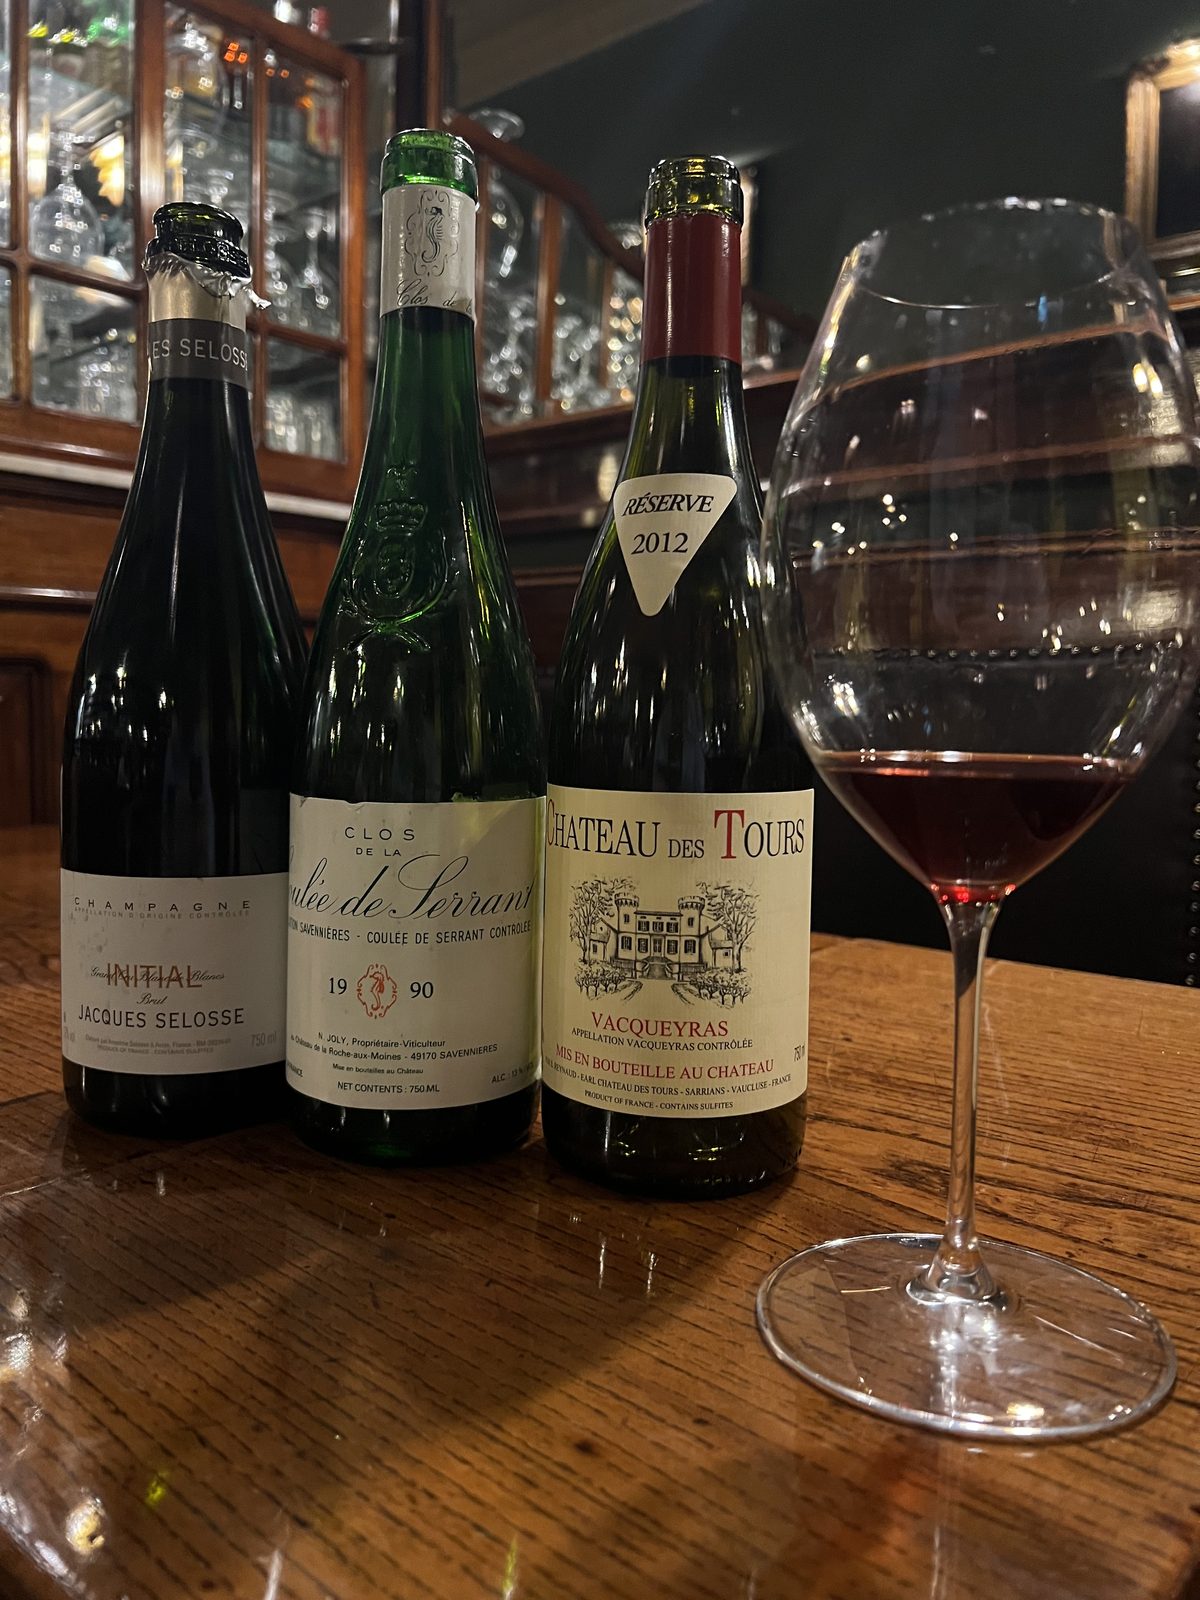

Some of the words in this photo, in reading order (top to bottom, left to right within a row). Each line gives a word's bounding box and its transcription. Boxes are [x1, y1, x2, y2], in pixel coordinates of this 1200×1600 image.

[397, 279, 429, 306] Clos
[621, 492, 714, 517] RÉSERVE
[631, 532, 689, 555] 2012
[344, 826, 416, 841] CLOS
[547, 799, 661, 857] CHATEAU
[668, 839, 705, 858] DES
[714, 809, 805, 859] TOURS
[356, 847, 373, 855] DE
[384, 849, 402, 857] LA
[331, 865, 392, 917] de
[388, 853, 538, 919] Serrant
[74, 897, 250, 912] CHAMPAGNE
[415, 932, 429, 944] DE
[436, 929, 485, 944] SERRANT
[107, 963, 202, 988] INITIAL
[328, 977, 347, 995] 19
[136, 993, 168, 1005] Brut
[410, 981, 434, 998] 90
[79, 1004, 146, 1028] JACQUES
[155, 1008, 244, 1028] SELOSSE
[591, 1012, 728, 1039] VACQUEYRAS
[571, 1027, 624, 1046] APPELLATION
[626, 1038, 695, 1051] VACQUEYRAS
[697, 1038, 753, 1051] CONTRÔLÉE
[329, 1047, 401, 1061] Roche-aux-Moines
[410, 1052, 437, 1060] 49170
[556, 1043, 572, 1061] MIS
[574, 1051, 590, 1067] EN
[592, 1057, 675, 1079] BOUTEILLE
[680, 1066, 703, 1079] AU
[707, 1059, 774, 1079] CHATEAU
[337, 1081, 352, 1091] NET
[355, 1083, 402, 1093] CONTENTS
[580, 1073, 597, 1085] EARL
[597, 1078, 632, 1092] CHATEAU
[634, 1084, 649, 1094] DES
[651, 1086, 679, 1096] TOURS
[685, 1086, 725, 1096] SARRIANS
[731, 1080, 768, 1093] VAUCLUSE
[771, 1074, 791, 1087] FRANCE
[584, 1090, 612, 1103] PRODUCT
[614, 1096, 623, 1104] OF
[625, 1099, 654, 1109] FRANCE
[660, 1102, 699, 1111] CONTAINS
[700, 1101, 733, 1110] SULFITES
